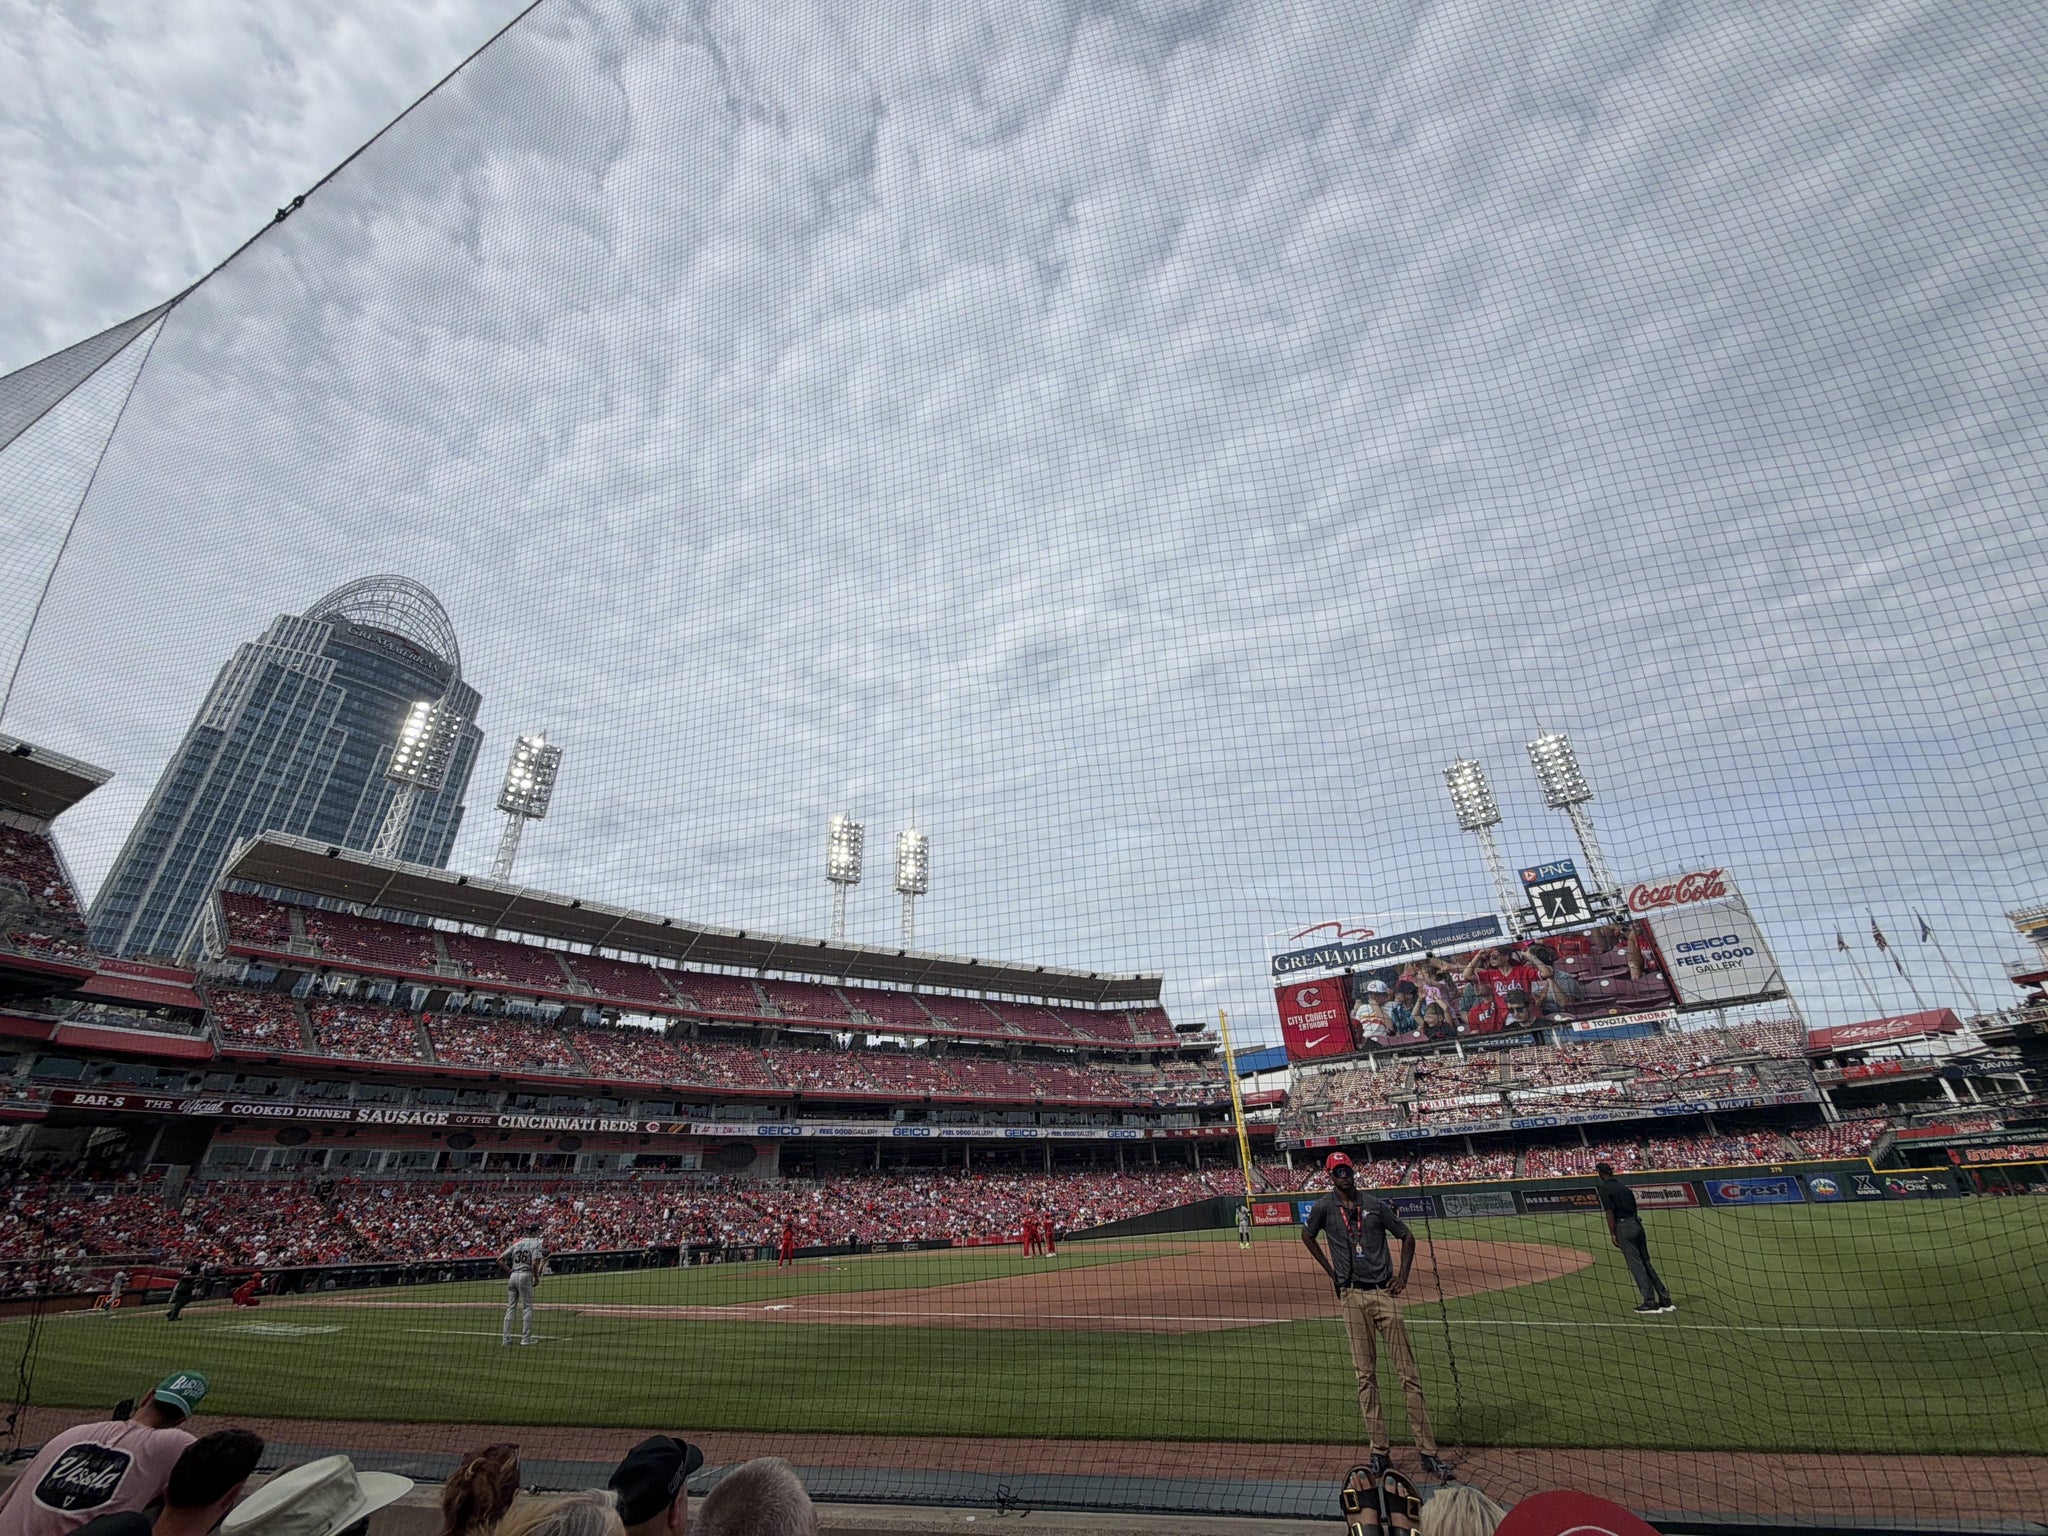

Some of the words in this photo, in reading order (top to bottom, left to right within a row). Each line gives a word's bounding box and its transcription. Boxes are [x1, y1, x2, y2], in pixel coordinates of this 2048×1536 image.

[1538, 861, 1573, 878] PNC
[1629, 868, 1727, 912] Coca-Cola
[1274, 949, 1333, 972] GREAT
[1430, 932, 1471, 946] INSURANCE
[1472, 927, 1497, 938] GROUP
[1676, 934, 1740, 953] GEICO
[1676, 954, 1710, 967] FEEL
[1711, 947, 1755, 961] GOOD
[1695, 960, 1743, 973] GALLERY
[1494, 979, 1523, 996] Reds
[1287, 1015, 1303, 1026] CITY
[1305, 1009, 1337, 1022] CONNECT
[1298, 1020, 1329, 1031] SATURDAY
[1592, 1017, 1628, 1027] TOYOTA
[1628, 1011, 1668, 1022] TUNDRA
[1719, 1099, 1751, 1109] WLWT
[72, 1094, 126, 1107] BAR-S
[144, 1099, 174, 1109] THE
[178, 1099, 224, 1115] Official
[230, 1104, 294, 1116] COOKED
[296, 1106, 351, 1119] DINNER
[356, 1109, 450, 1125] SAUSAGE
[471, 1116, 492, 1124] THE
[497, 1115, 596, 1131] CINCINNATI
[598, 1120, 639, 1132] REDS
[1389, 1128, 1430, 1139] GEICO
[1510, 1117, 1558, 1128] GEICO
[1587, 1113, 1609, 1121] GOOD
[1653, 1101, 1710, 1115] GEICO
[757, 1126, 802, 1136] GEICO
[892, 1127, 931, 1136] GEICO
[1004, 1129, 1038, 1137] GEICO
[1107, 1130, 1137, 1138] GEICO
[1965, 1148, 2008, 1162] STAR
[1525, 1194, 1598, 1204] MILESTAR
[1640, 1190, 1664, 1199] Jimmy
[1720, 1182, 1788, 1199] Crest
[1255, 1215, 1291, 1224] Budweiser
[514, 1250, 528, 1264] 36
[52, 1456, 121, 1489] Vissla
